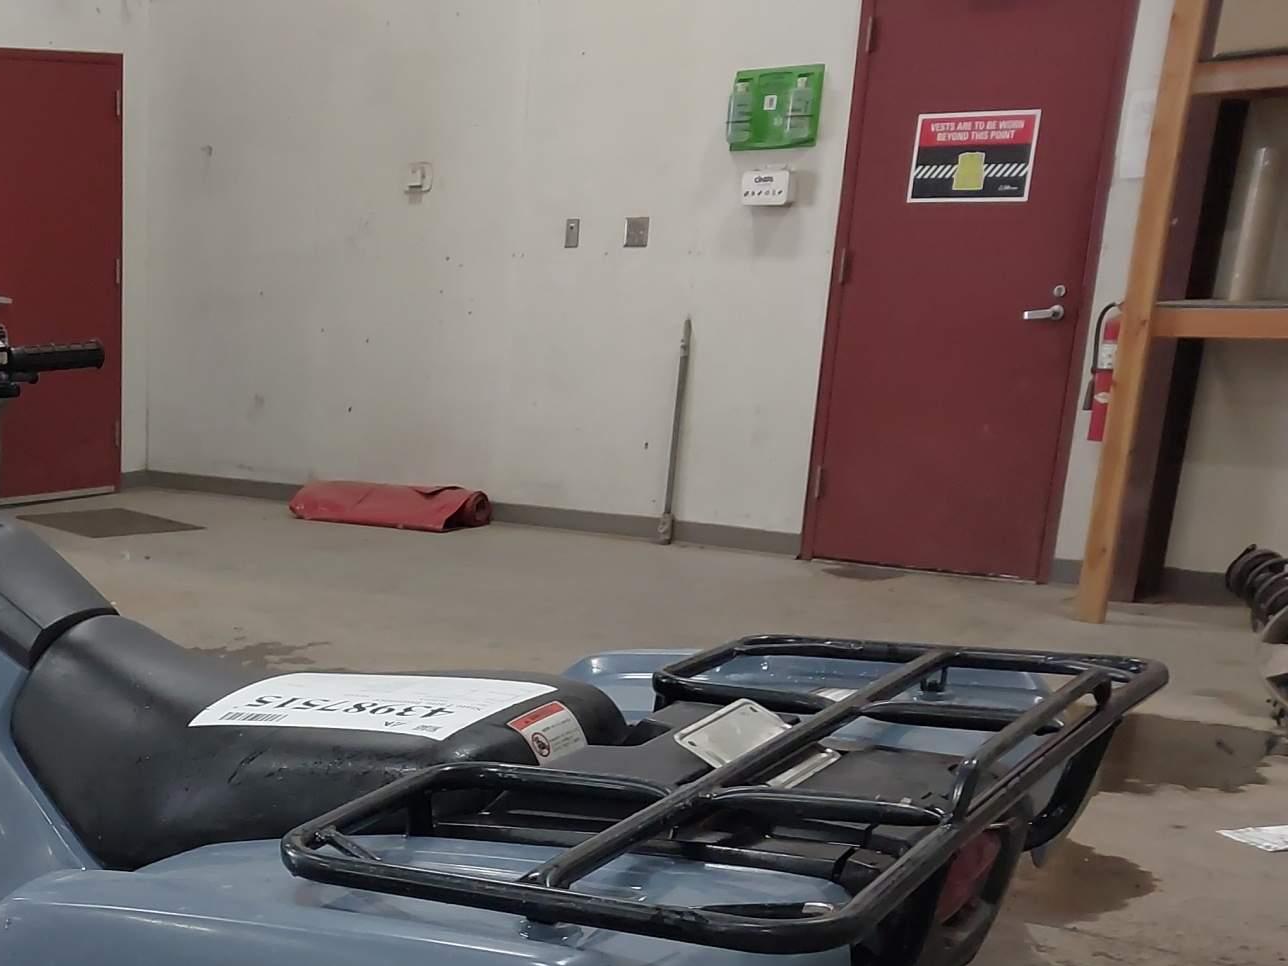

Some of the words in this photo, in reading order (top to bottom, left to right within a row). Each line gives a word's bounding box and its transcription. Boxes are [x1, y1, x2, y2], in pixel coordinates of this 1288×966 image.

[931, 122, 955, 132] VESTS
[956, 121, 972, 131] ARE
[974, 121, 985, 130] TO
[986, 120, 998, 130] BE
[936, 131, 969, 141] BEYOND
[971, 130, 989, 140] THIS
[990, 129, 1016, 140] POINT
[247, 695, 455, 718] 43987515
